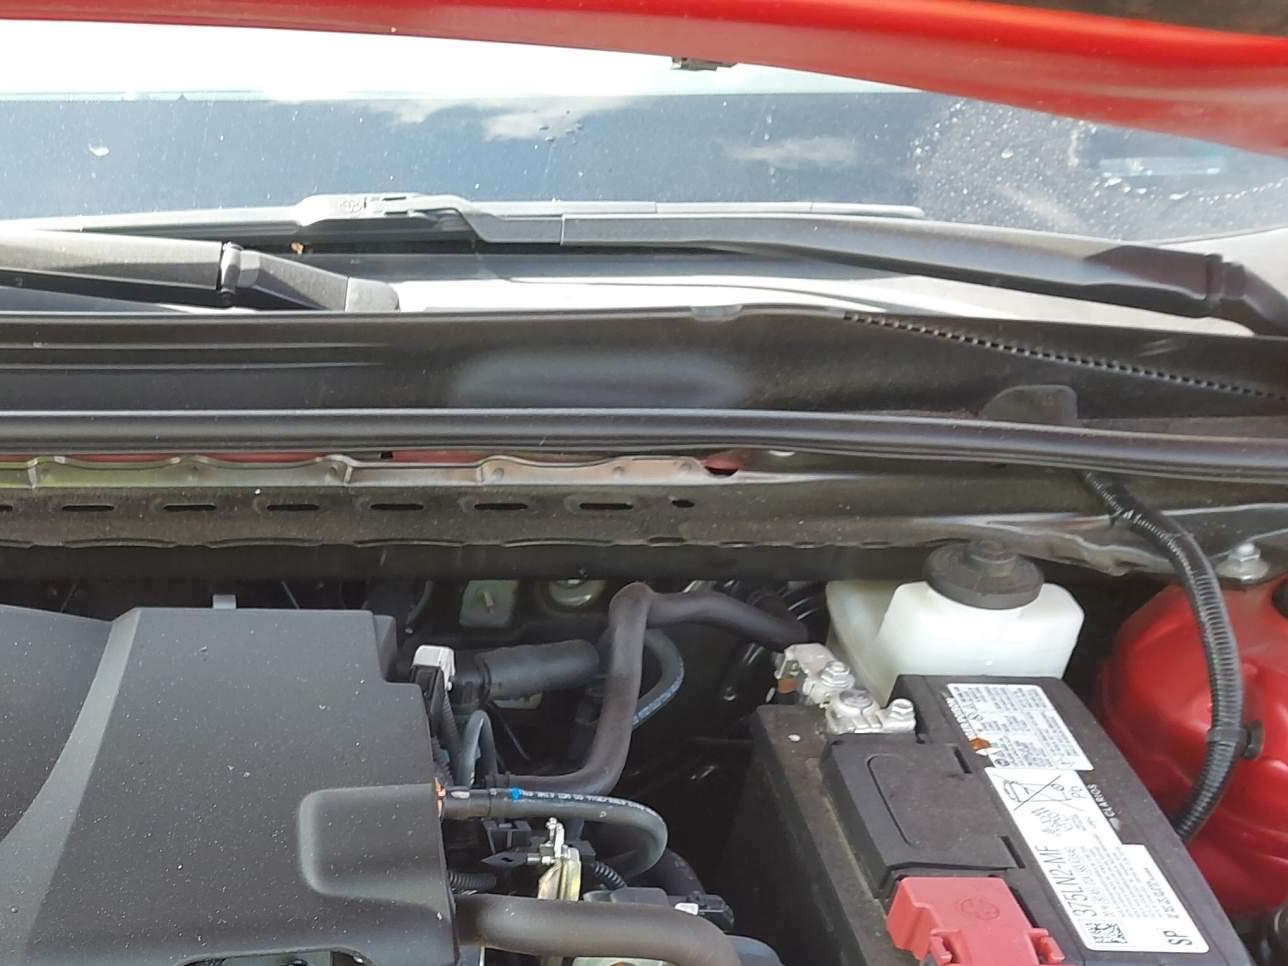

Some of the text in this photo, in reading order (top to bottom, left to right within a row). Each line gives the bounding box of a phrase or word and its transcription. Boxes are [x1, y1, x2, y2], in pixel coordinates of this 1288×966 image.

[1087, 783, 1116, 818] CLARIOS
[1034, 845, 1098, 918] 375LN2-MF
[1162, 929, 1193, 947] SP
